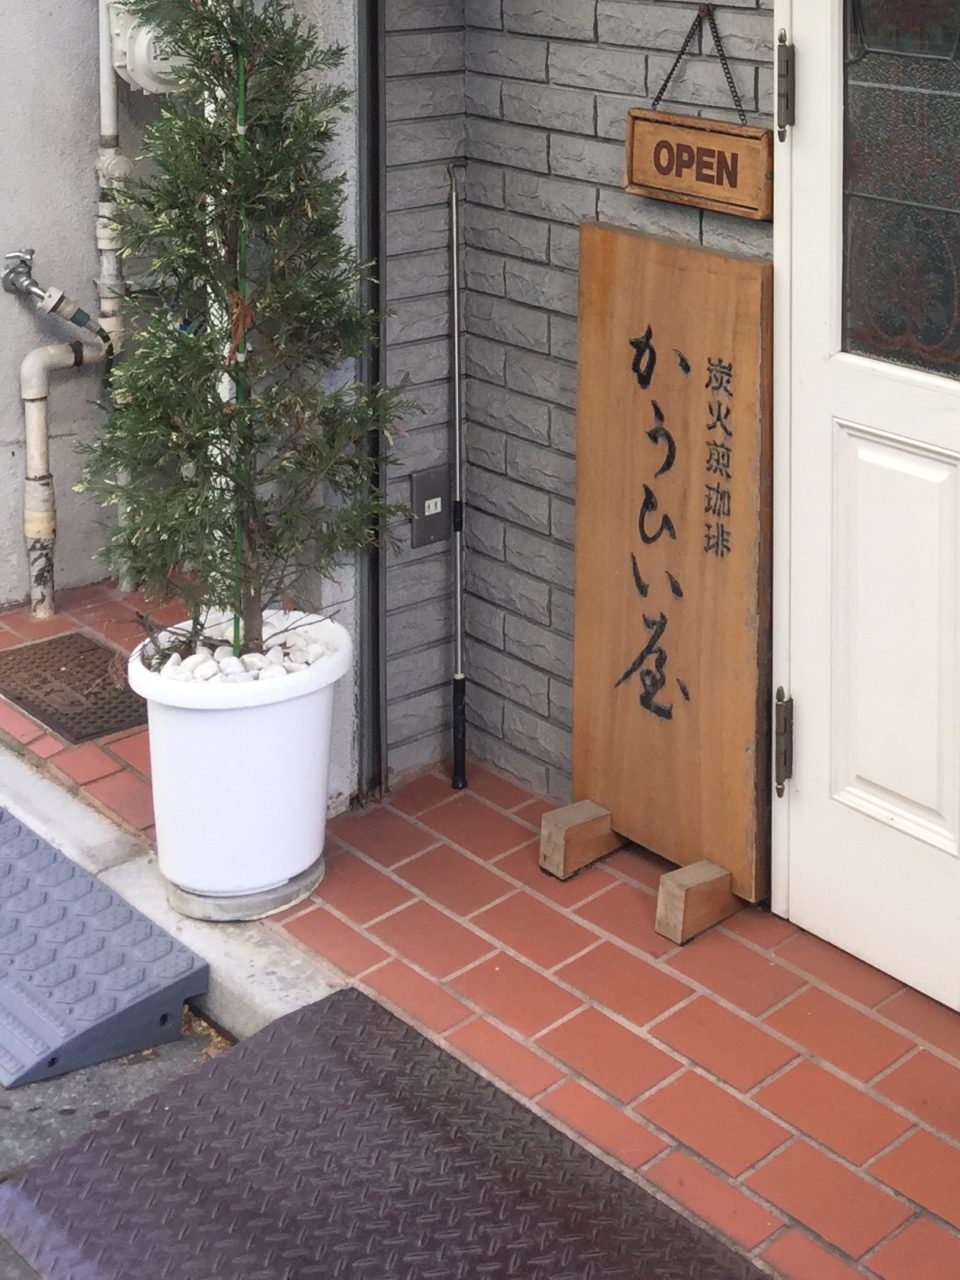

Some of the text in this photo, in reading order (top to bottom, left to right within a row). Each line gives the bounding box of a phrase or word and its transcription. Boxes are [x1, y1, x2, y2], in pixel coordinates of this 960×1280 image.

[653, 139, 738, 189] OPEN
[613, 323, 691, 721] かうひい屋
[704, 356, 733, 560] 炭火煎珈琲
